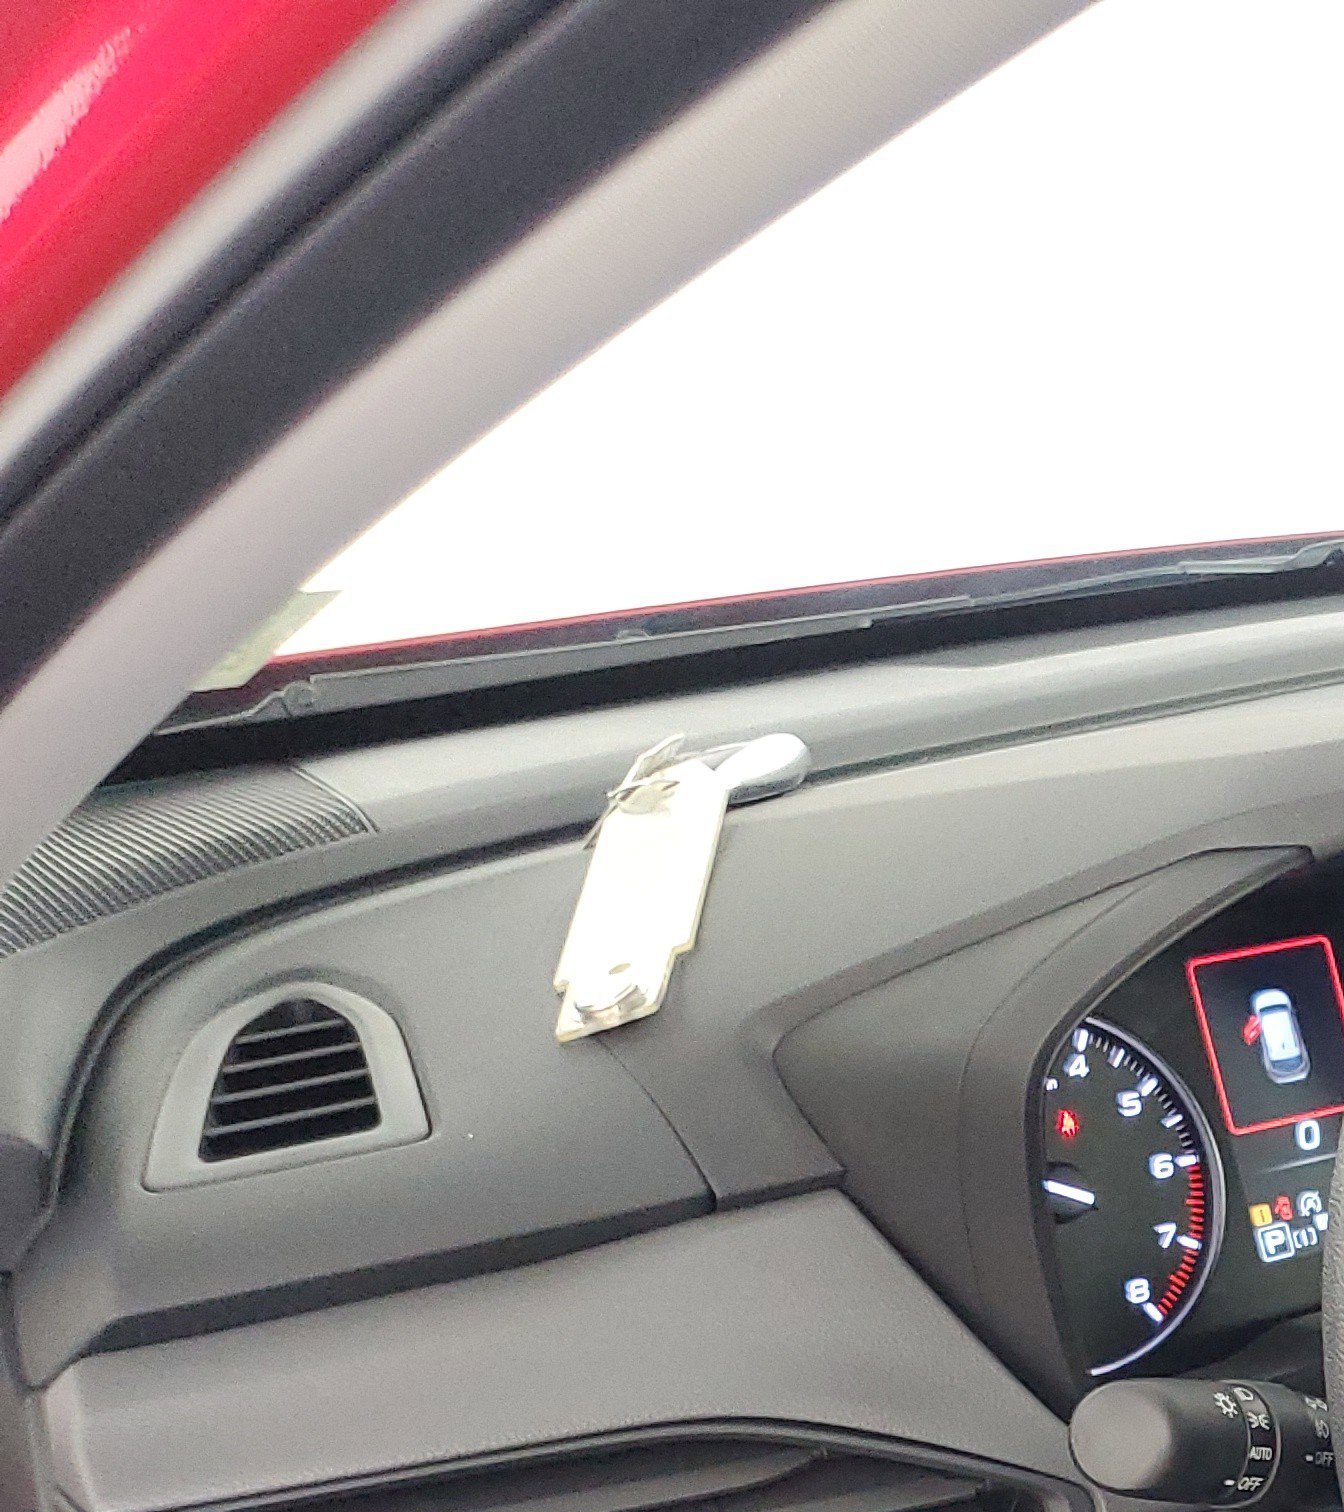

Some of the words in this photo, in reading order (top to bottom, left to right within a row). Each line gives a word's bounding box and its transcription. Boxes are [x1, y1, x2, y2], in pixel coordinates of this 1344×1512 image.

[1064, 1053, 1090, 1078] 4
[1116, 1091, 1142, 1117] 5
[1149, 1153, 1174, 1179] 6
[1153, 1222, 1177, 1249] 7
[1124, 1277, 1150, 1304] 8
[1249, 1446, 1273, 1461] AUTO
[1237, 1476, 1264, 1491] OFF
